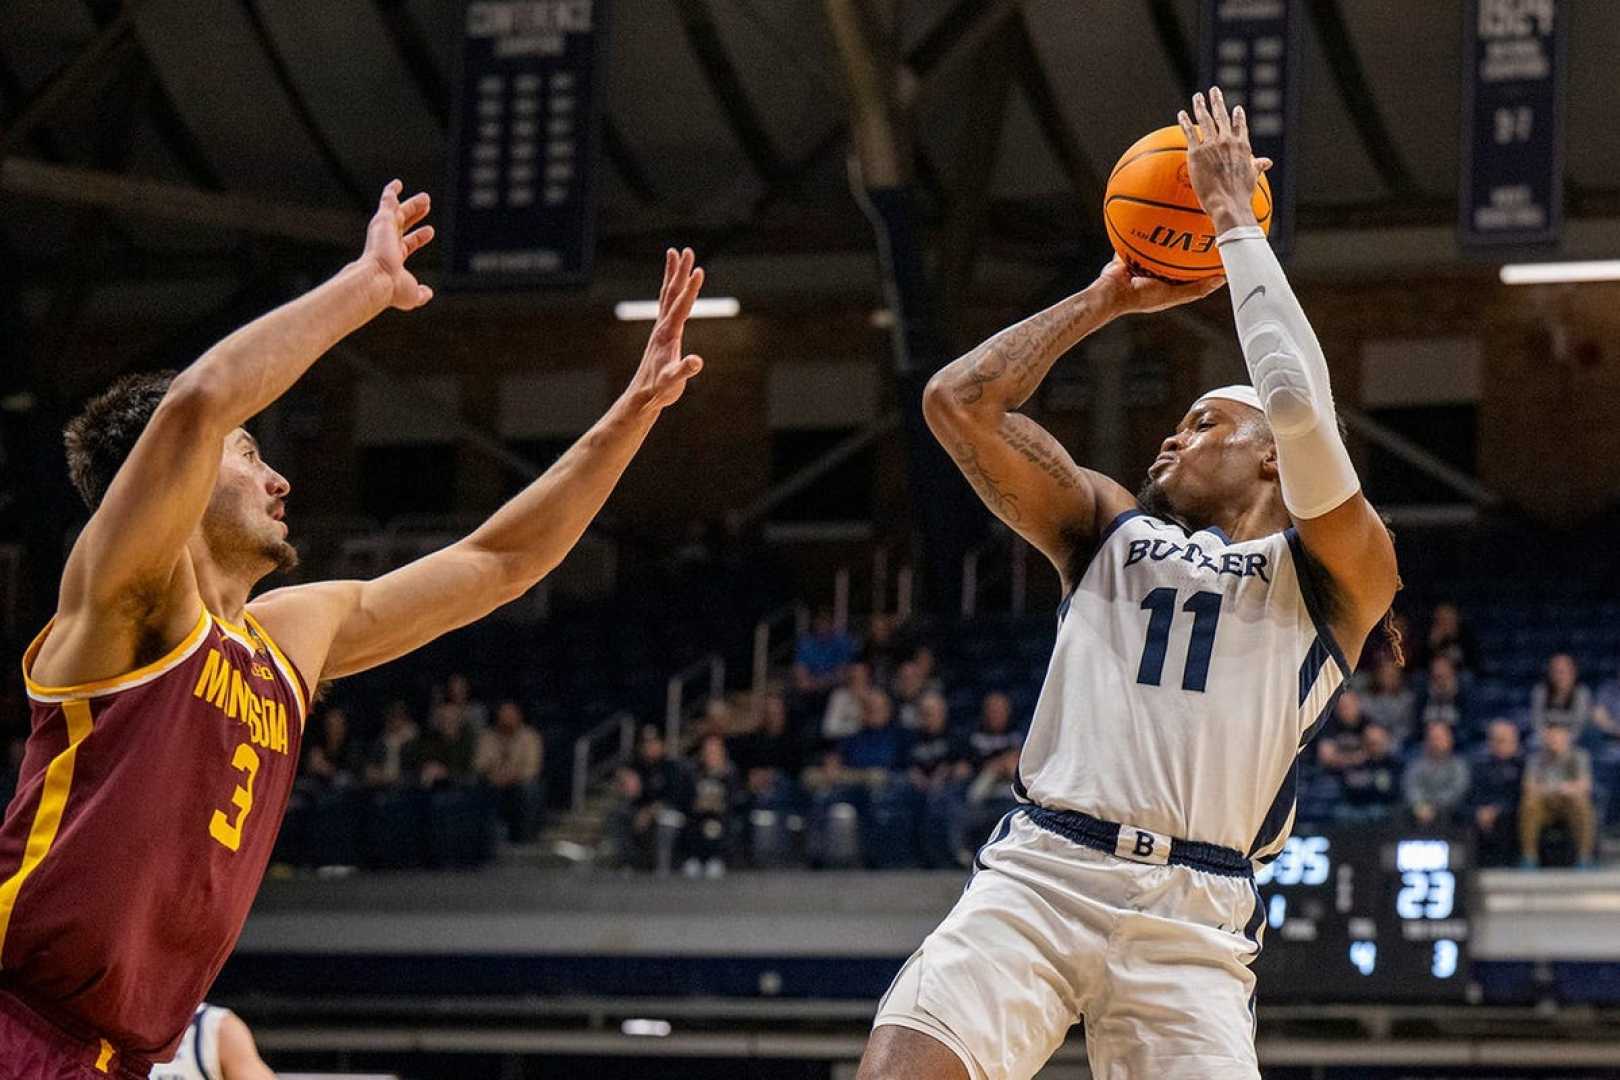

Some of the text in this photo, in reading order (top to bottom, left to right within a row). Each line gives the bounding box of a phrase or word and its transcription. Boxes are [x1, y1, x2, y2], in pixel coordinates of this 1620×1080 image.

[1149, 225, 1216, 253] EVO
[1123, 539, 1269, 583] BUTLER
[1136, 587, 1224, 693] 11
[208, 742, 261, 852] 3
[1132, 831, 1155, 858] B
[1396, 871, 1455, 919] 23
